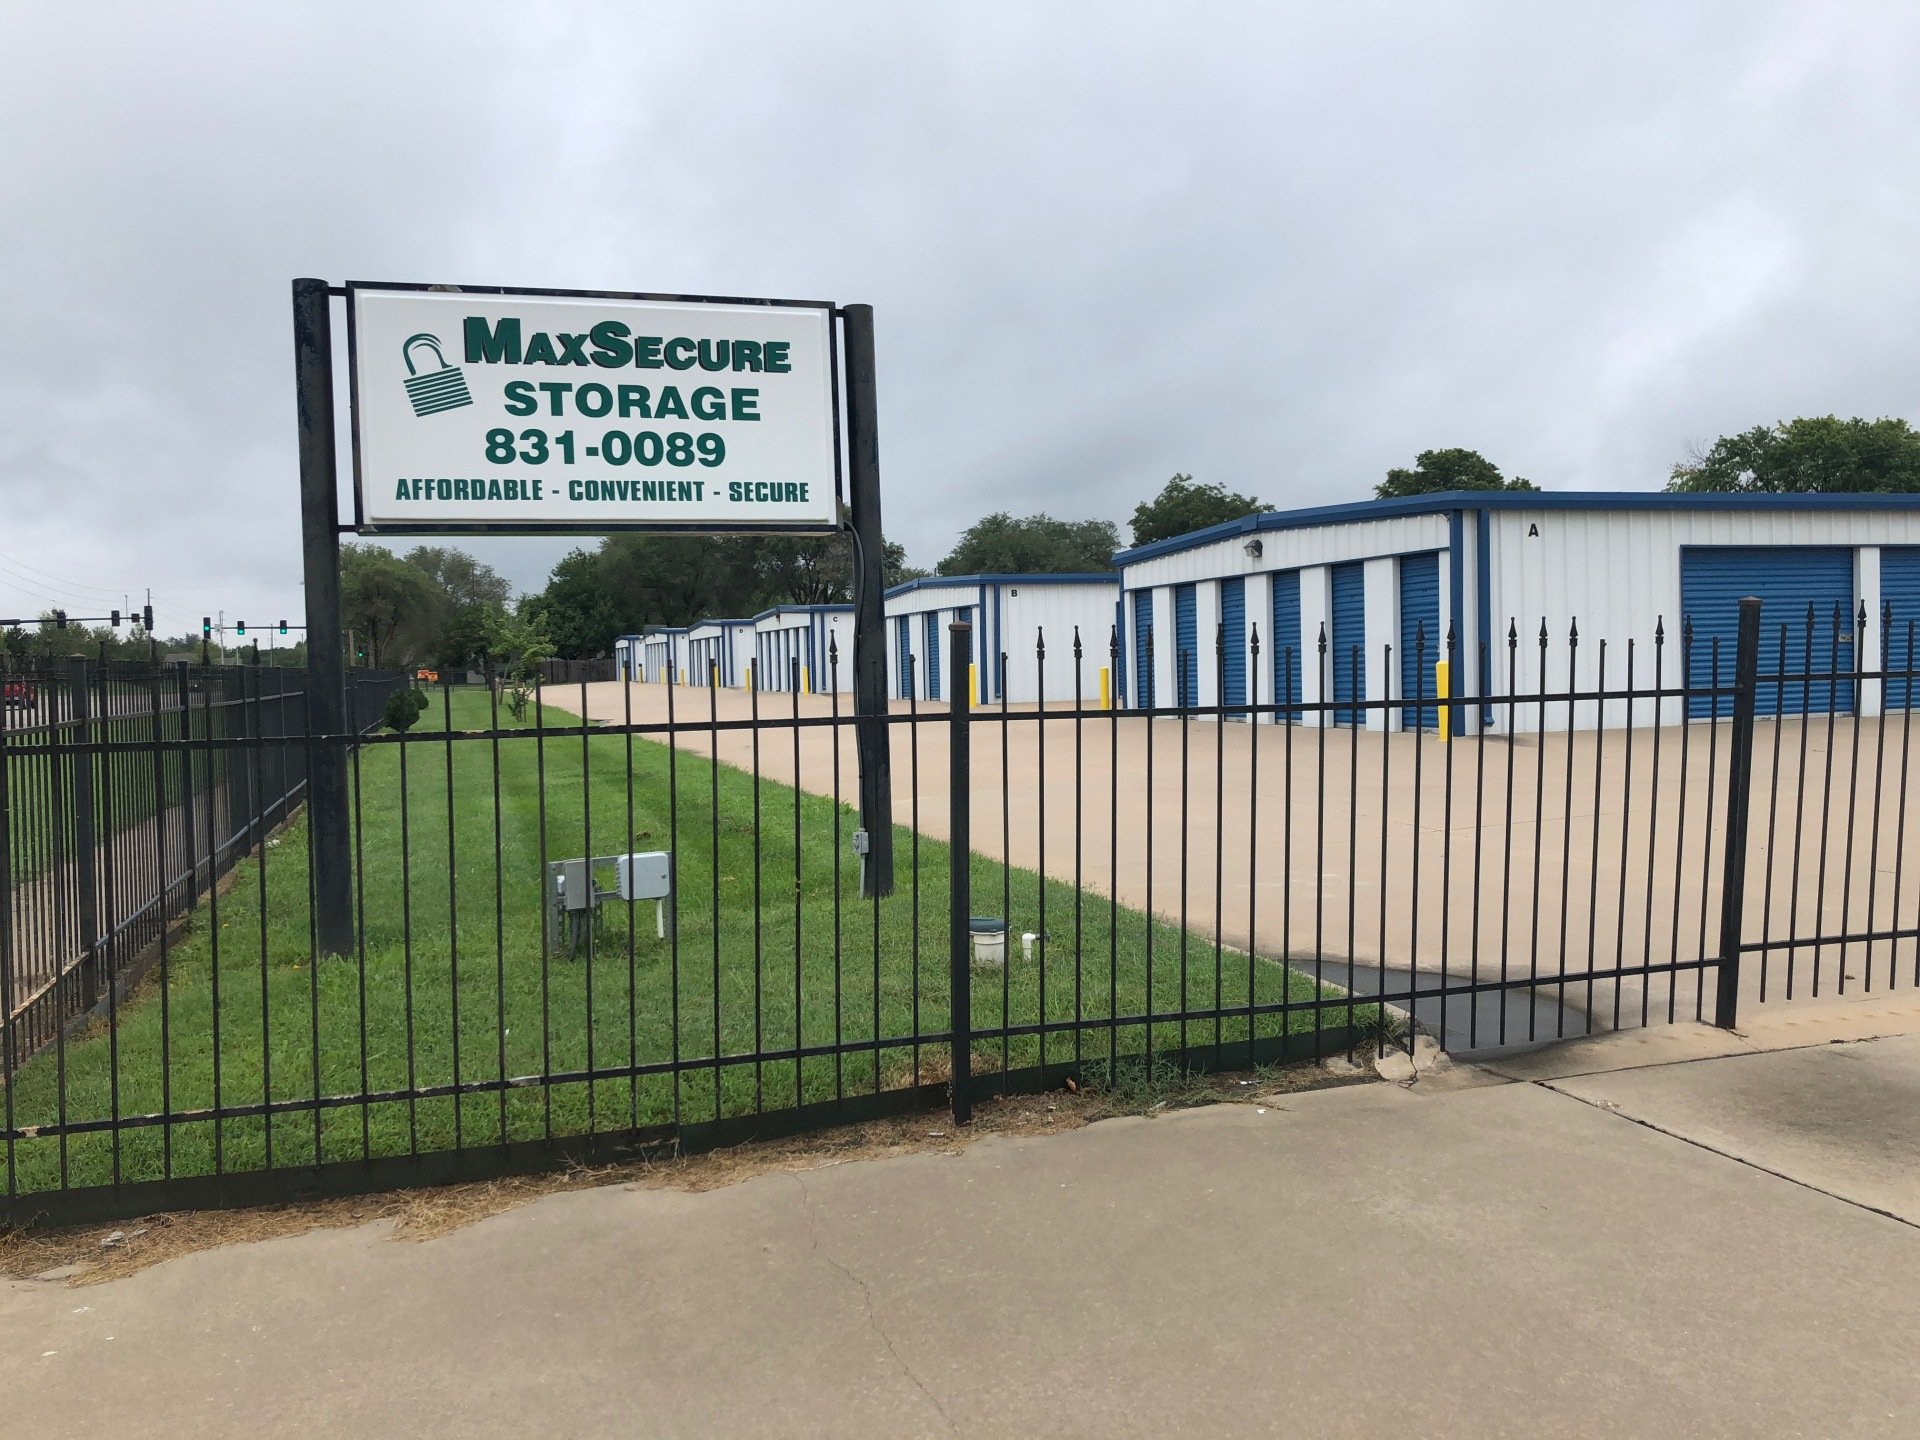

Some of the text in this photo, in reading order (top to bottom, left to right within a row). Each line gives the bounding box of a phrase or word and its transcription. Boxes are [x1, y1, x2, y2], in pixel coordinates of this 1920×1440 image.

[504, 380, 761, 421] STORAGE
[485, 428, 726, 467] 831-0089
[396, 478, 543, 501] AFFORDABLE
[568, 480, 704, 502] CONVENIENT
[729, 482, 809, 503] SECURE
[1528, 523, 1539, 537] A
[1011, 589, 1018, 597] B
